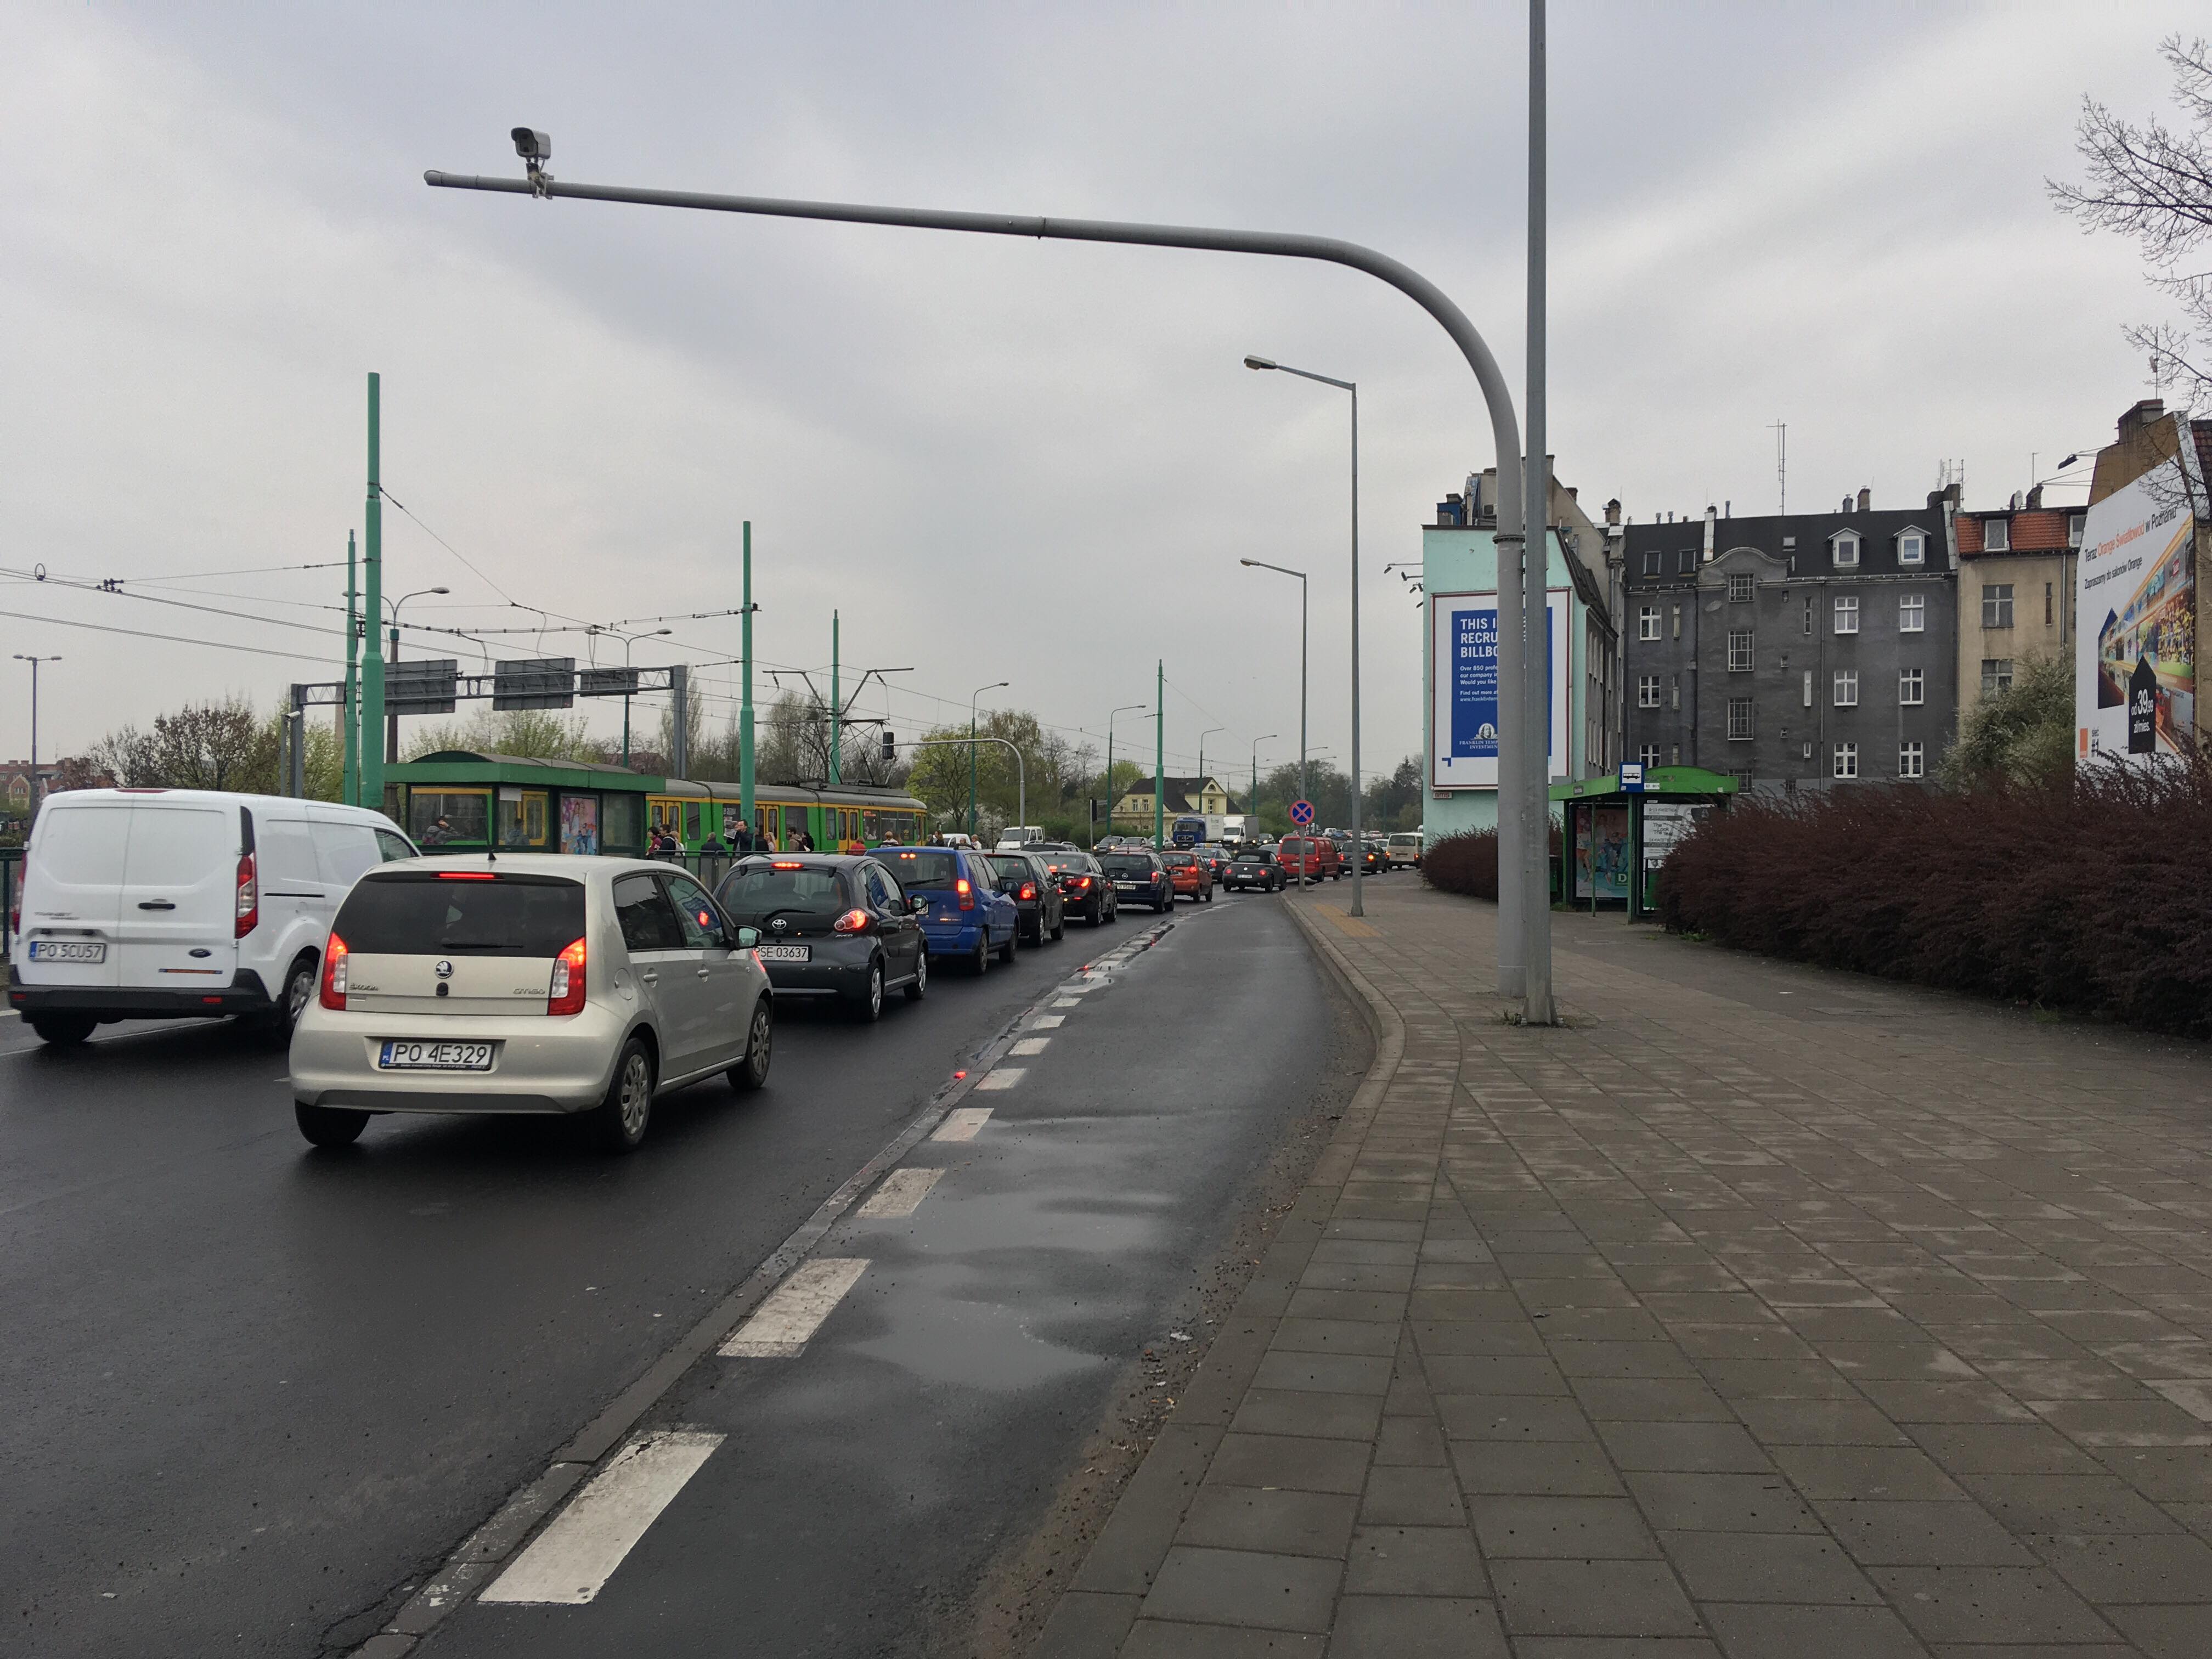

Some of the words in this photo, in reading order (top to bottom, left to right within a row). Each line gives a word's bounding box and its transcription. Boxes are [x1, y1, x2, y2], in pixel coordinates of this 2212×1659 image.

[2085, 549, 2097, 562] Teraz
[2097, 539, 2115, 556] Orange
[2145, 520, 2151, 533] w
[2084, 574, 2106, 590] Zapraszamy
[2106, 569, 2112, 581] do
[2128, 557, 2142, 571] Orange
[1460, 618, 1488, 630] THIS
[1492, 618, 1498, 629] I
[2131, 703, 2137, 715] od
[38, 944, 57, 957] PO
[776, 947, 808, 958] 03637
[393, 1044, 422, 1062] PO
[428, 1044, 487, 1064] 4E329
